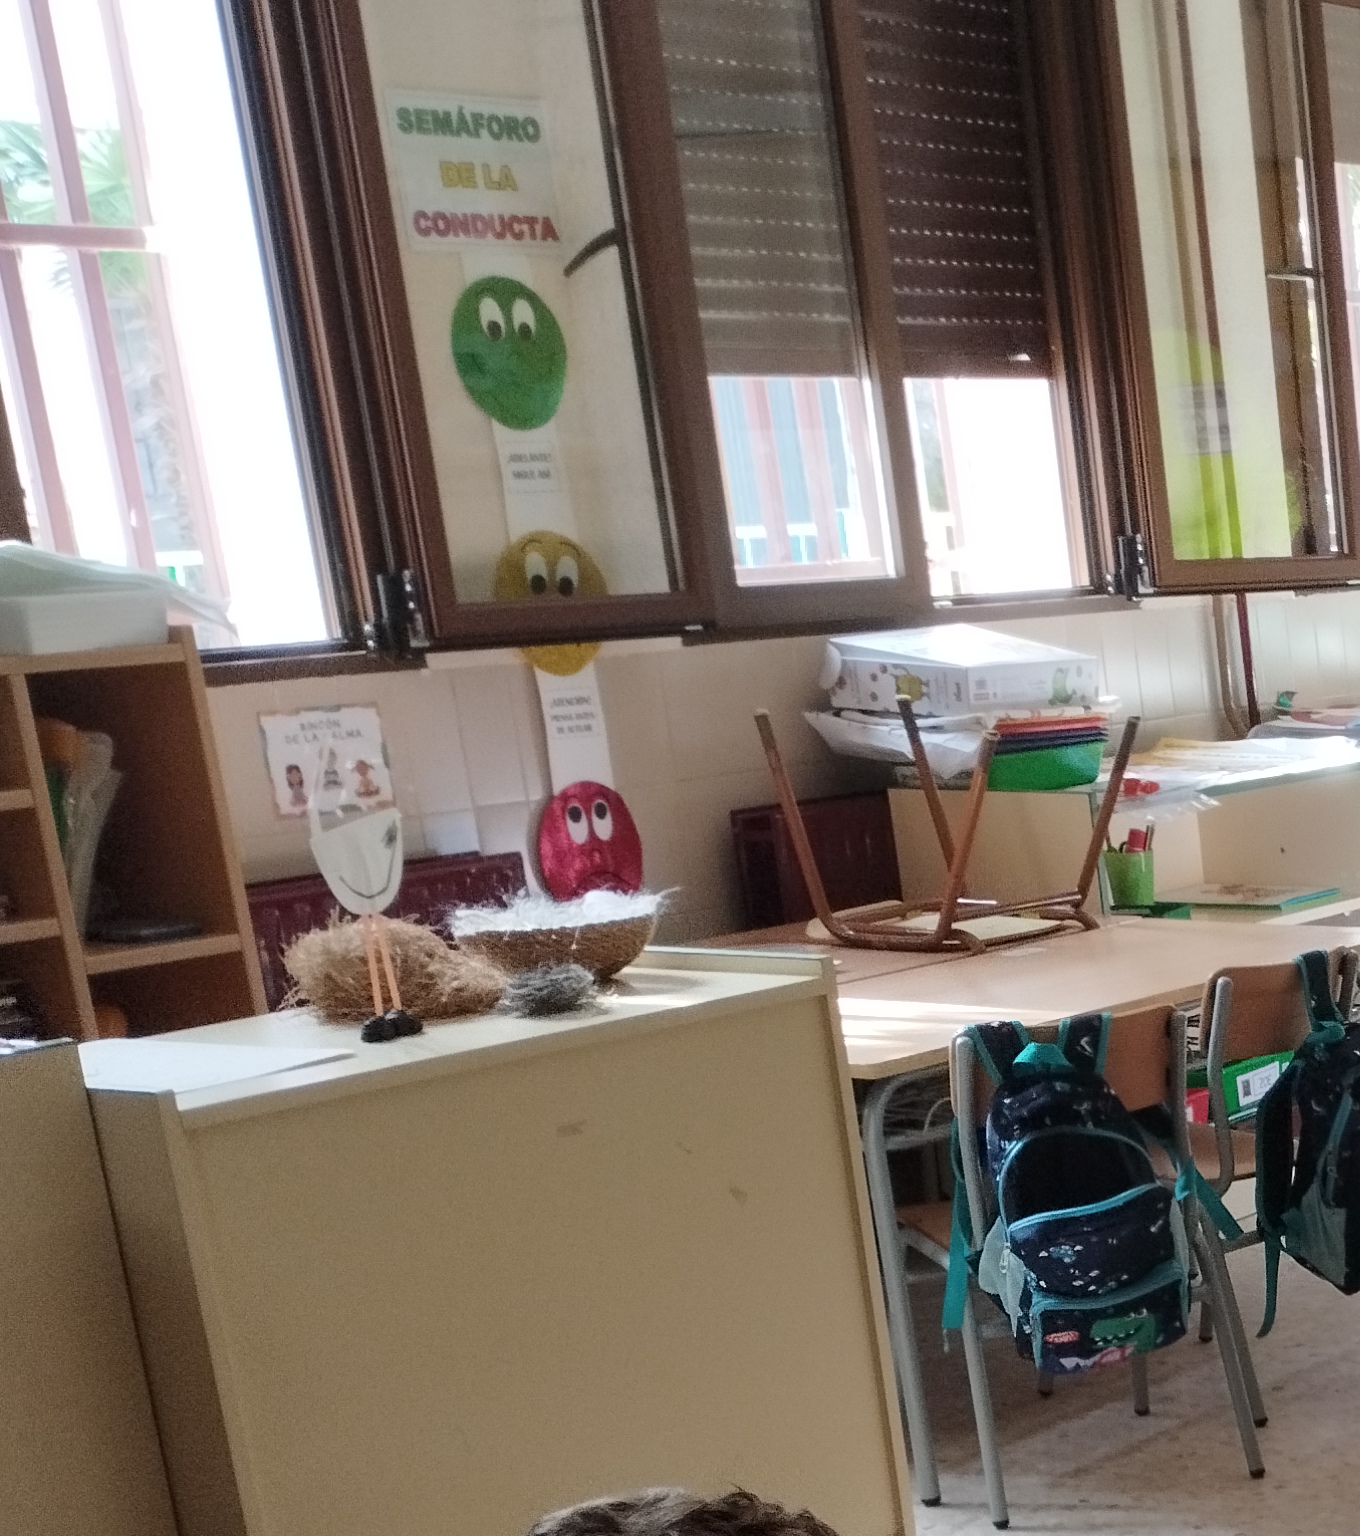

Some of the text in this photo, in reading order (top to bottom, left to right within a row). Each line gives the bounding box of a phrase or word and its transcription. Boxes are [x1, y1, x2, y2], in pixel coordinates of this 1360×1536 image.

[396, 105, 541, 143] SEMÁFORO
[439, 161, 518, 191] DE LA
[413, 210, 560, 242] CONDUCTA
